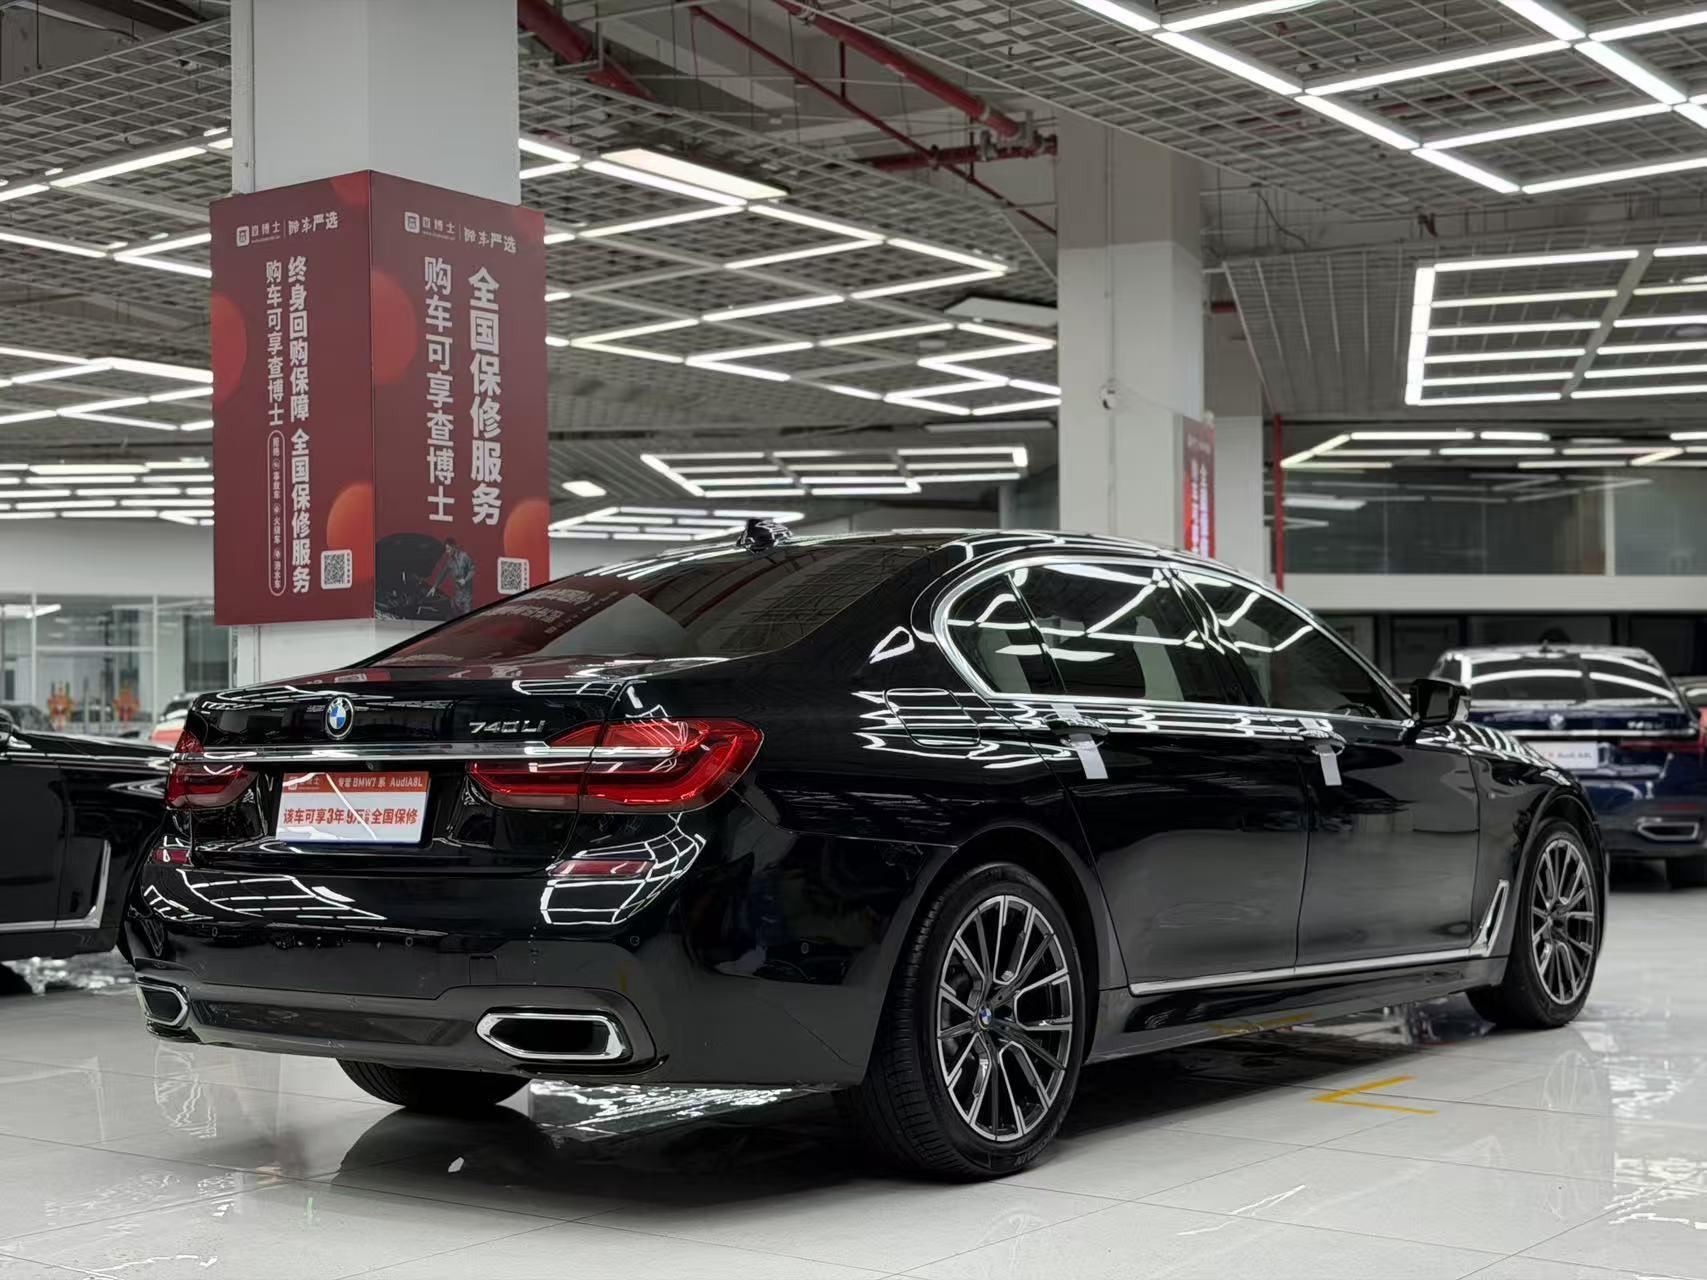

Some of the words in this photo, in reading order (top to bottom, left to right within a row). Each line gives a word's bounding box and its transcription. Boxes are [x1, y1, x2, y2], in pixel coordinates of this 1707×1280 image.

[266, 260, 285, 427] 购车可享查博士
[288, 255, 309, 423] 终身回购保障
[424, 256, 455, 523] 购车可享查博士
[467, 266, 502, 526] 全国保修服务
[290, 428, 311, 594] 全国保修服务
